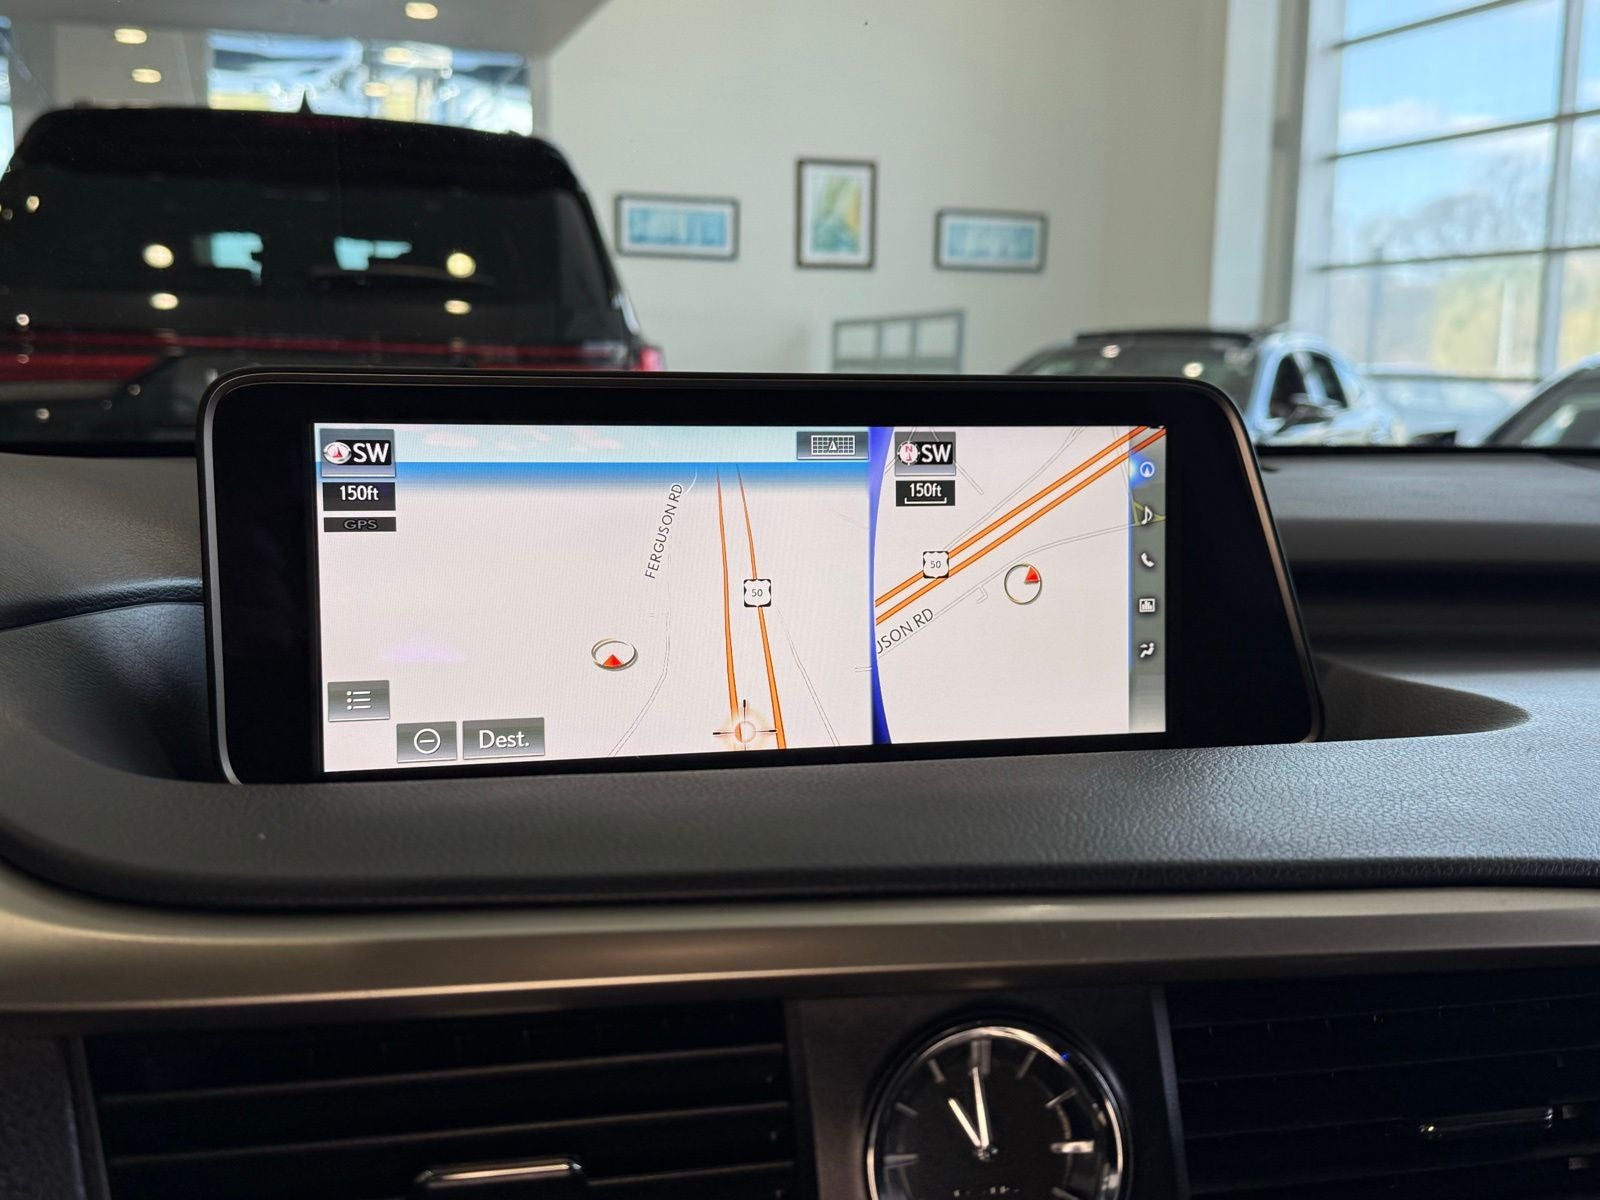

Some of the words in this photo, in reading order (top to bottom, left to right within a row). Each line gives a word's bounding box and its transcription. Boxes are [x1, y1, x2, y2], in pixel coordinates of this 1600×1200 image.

[353, 443, 389, 463] SW
[921, 444, 952, 463] SW
[339, 485, 379, 500] 150ft
[910, 482, 942, 497] 150ft
[344, 519, 377, 530] GPS
[644, 503, 677, 579] FERGUSON
[668, 484, 683, 503] RD
[930, 560, 942, 569] 50
[751, 588, 764, 598] 50
[912, 608, 934, 628] RD
[478, 729, 530, 749] Dest.
